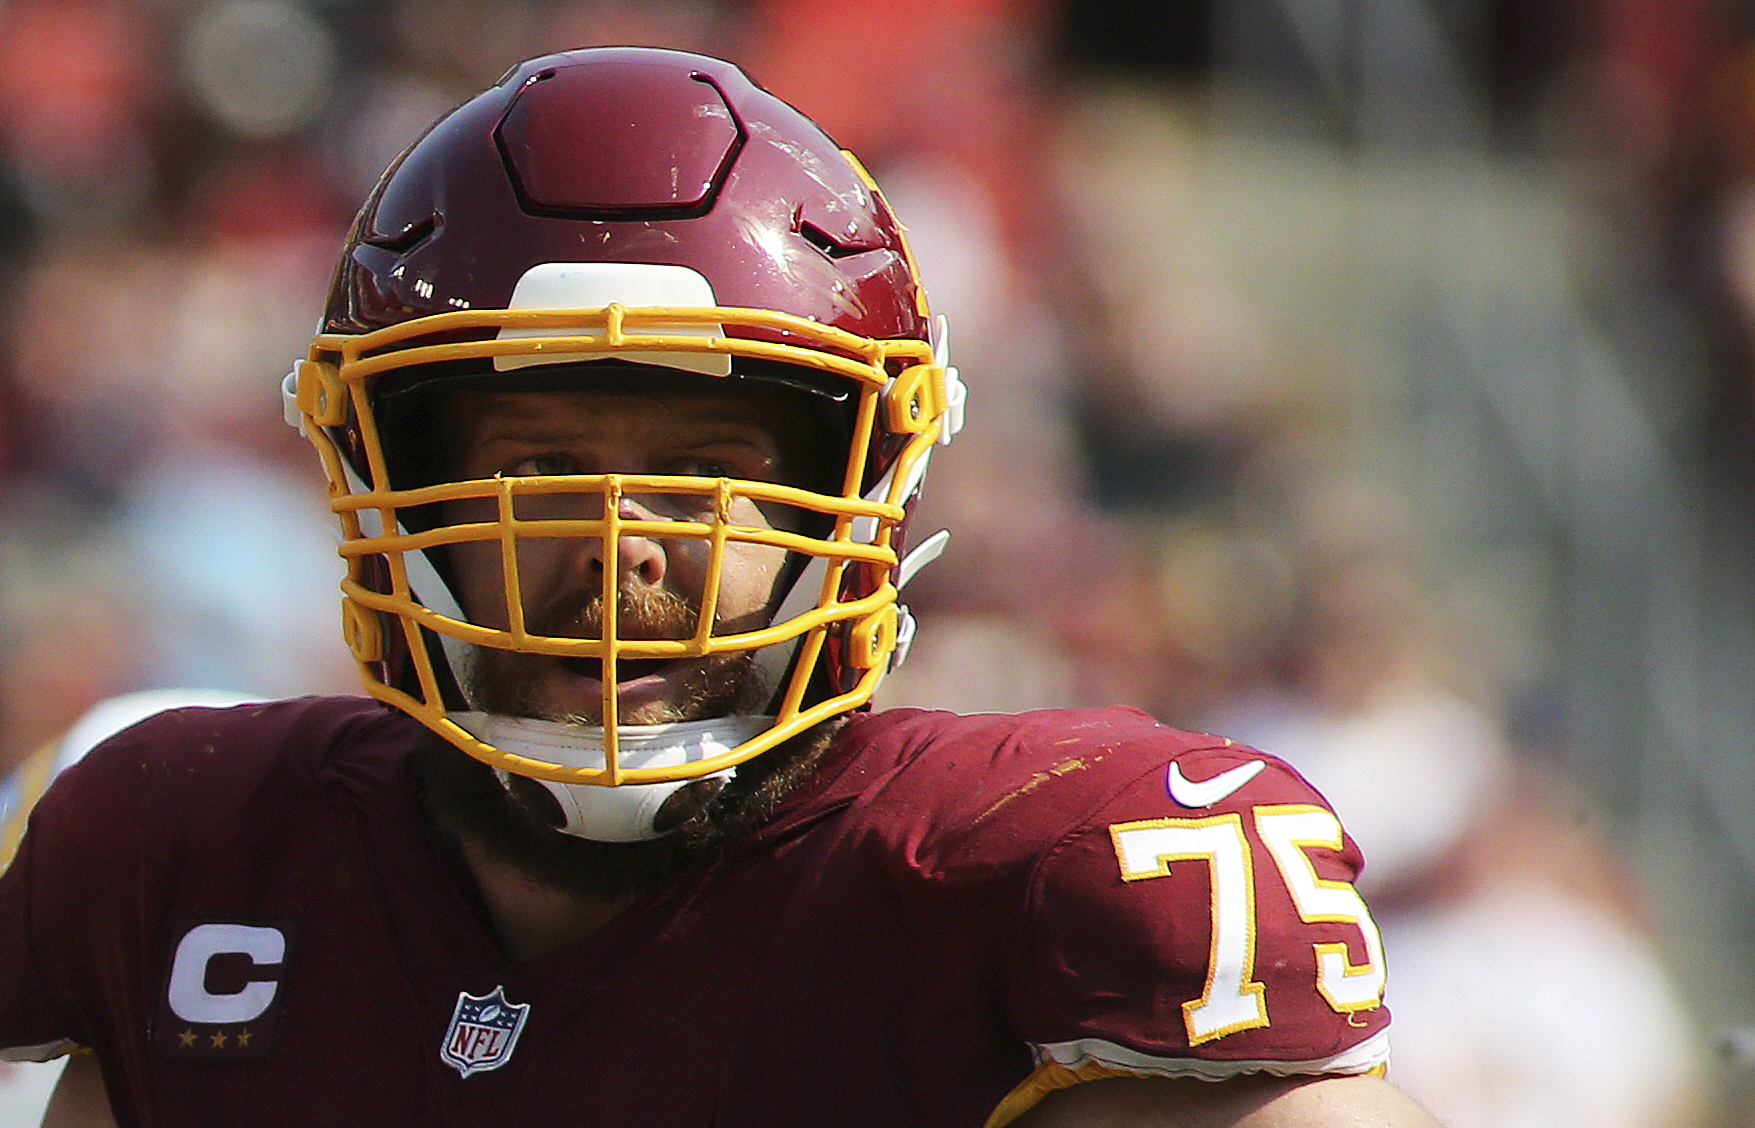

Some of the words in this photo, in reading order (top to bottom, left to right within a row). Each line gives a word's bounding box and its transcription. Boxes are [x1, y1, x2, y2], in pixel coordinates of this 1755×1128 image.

[168, 923, 286, 1024] C
[1108, 804, 1388, 1047] 75
[451, 1026, 501, 1059] NFL
